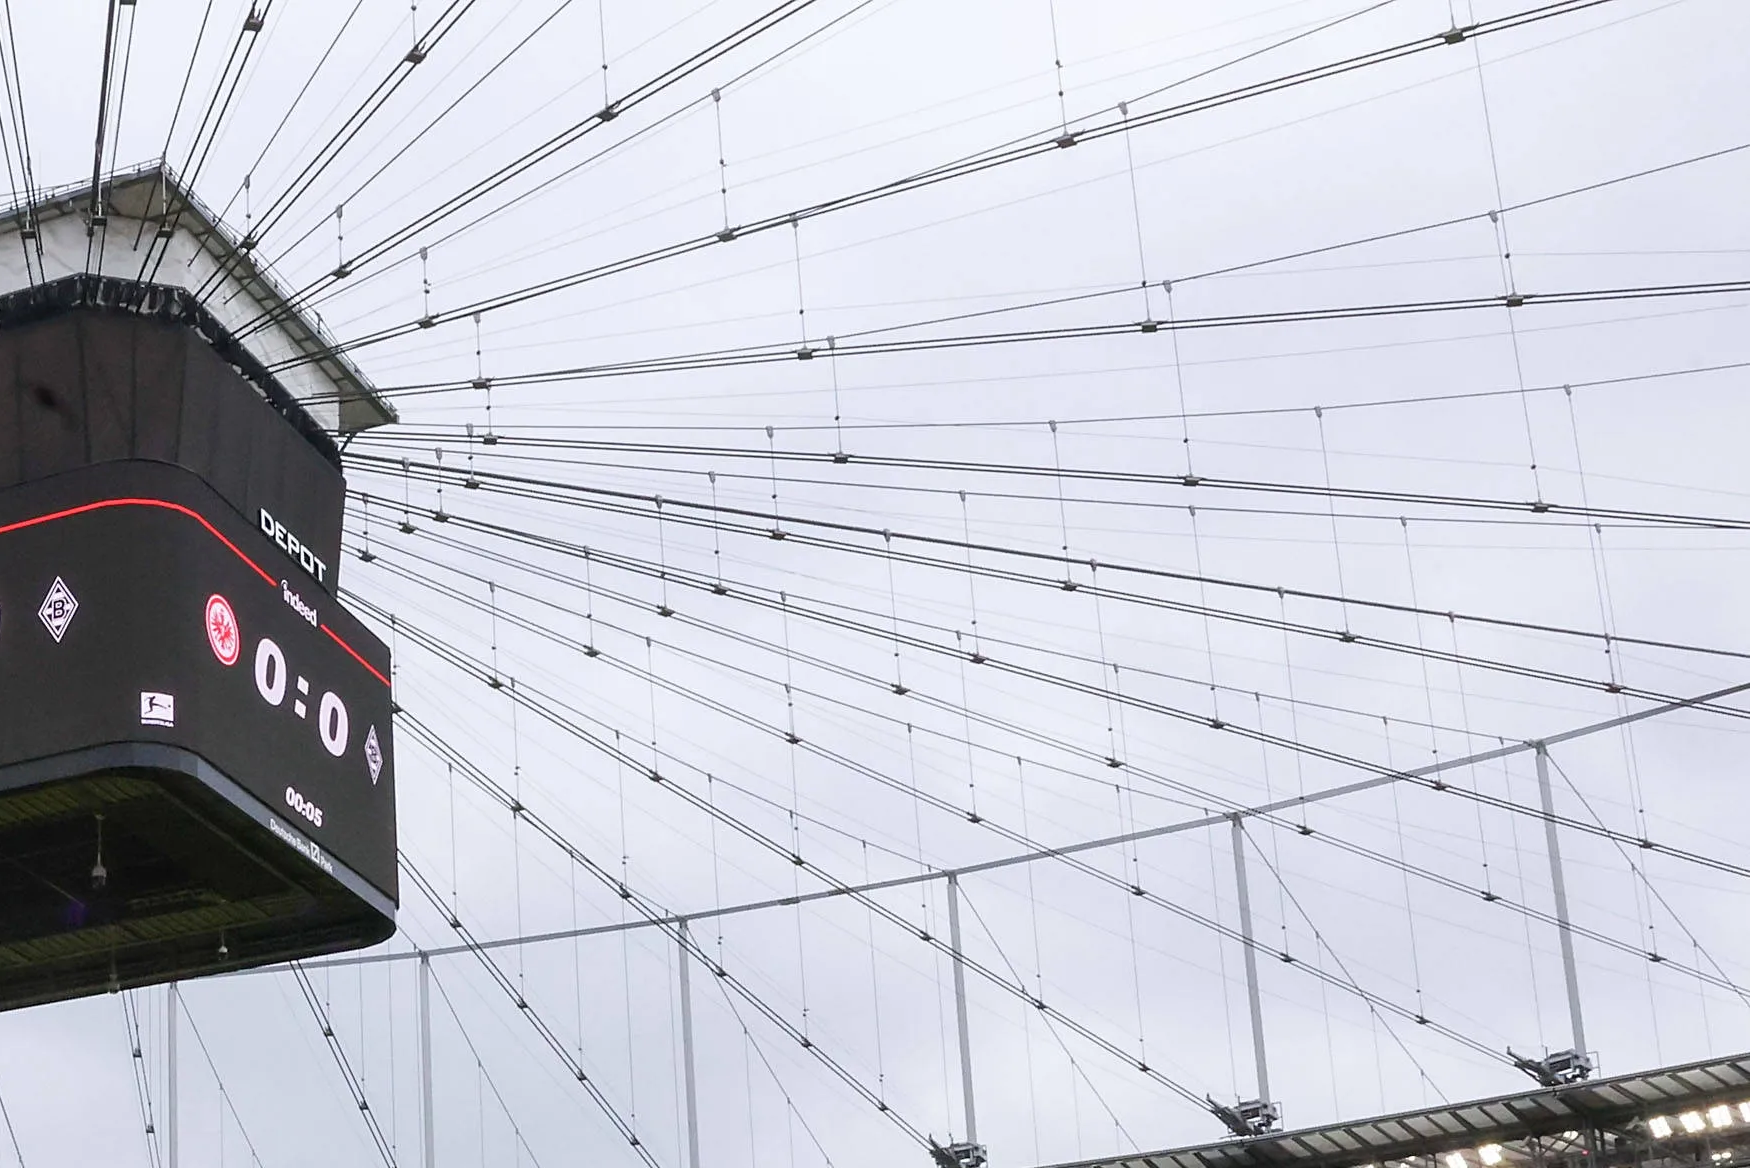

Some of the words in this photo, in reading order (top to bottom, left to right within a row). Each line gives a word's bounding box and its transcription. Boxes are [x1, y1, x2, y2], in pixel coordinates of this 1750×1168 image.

[260, 507, 327, 582] DEPOT
[281, 579, 317, 627] indeed
[285, 786, 323, 828] 00:05
